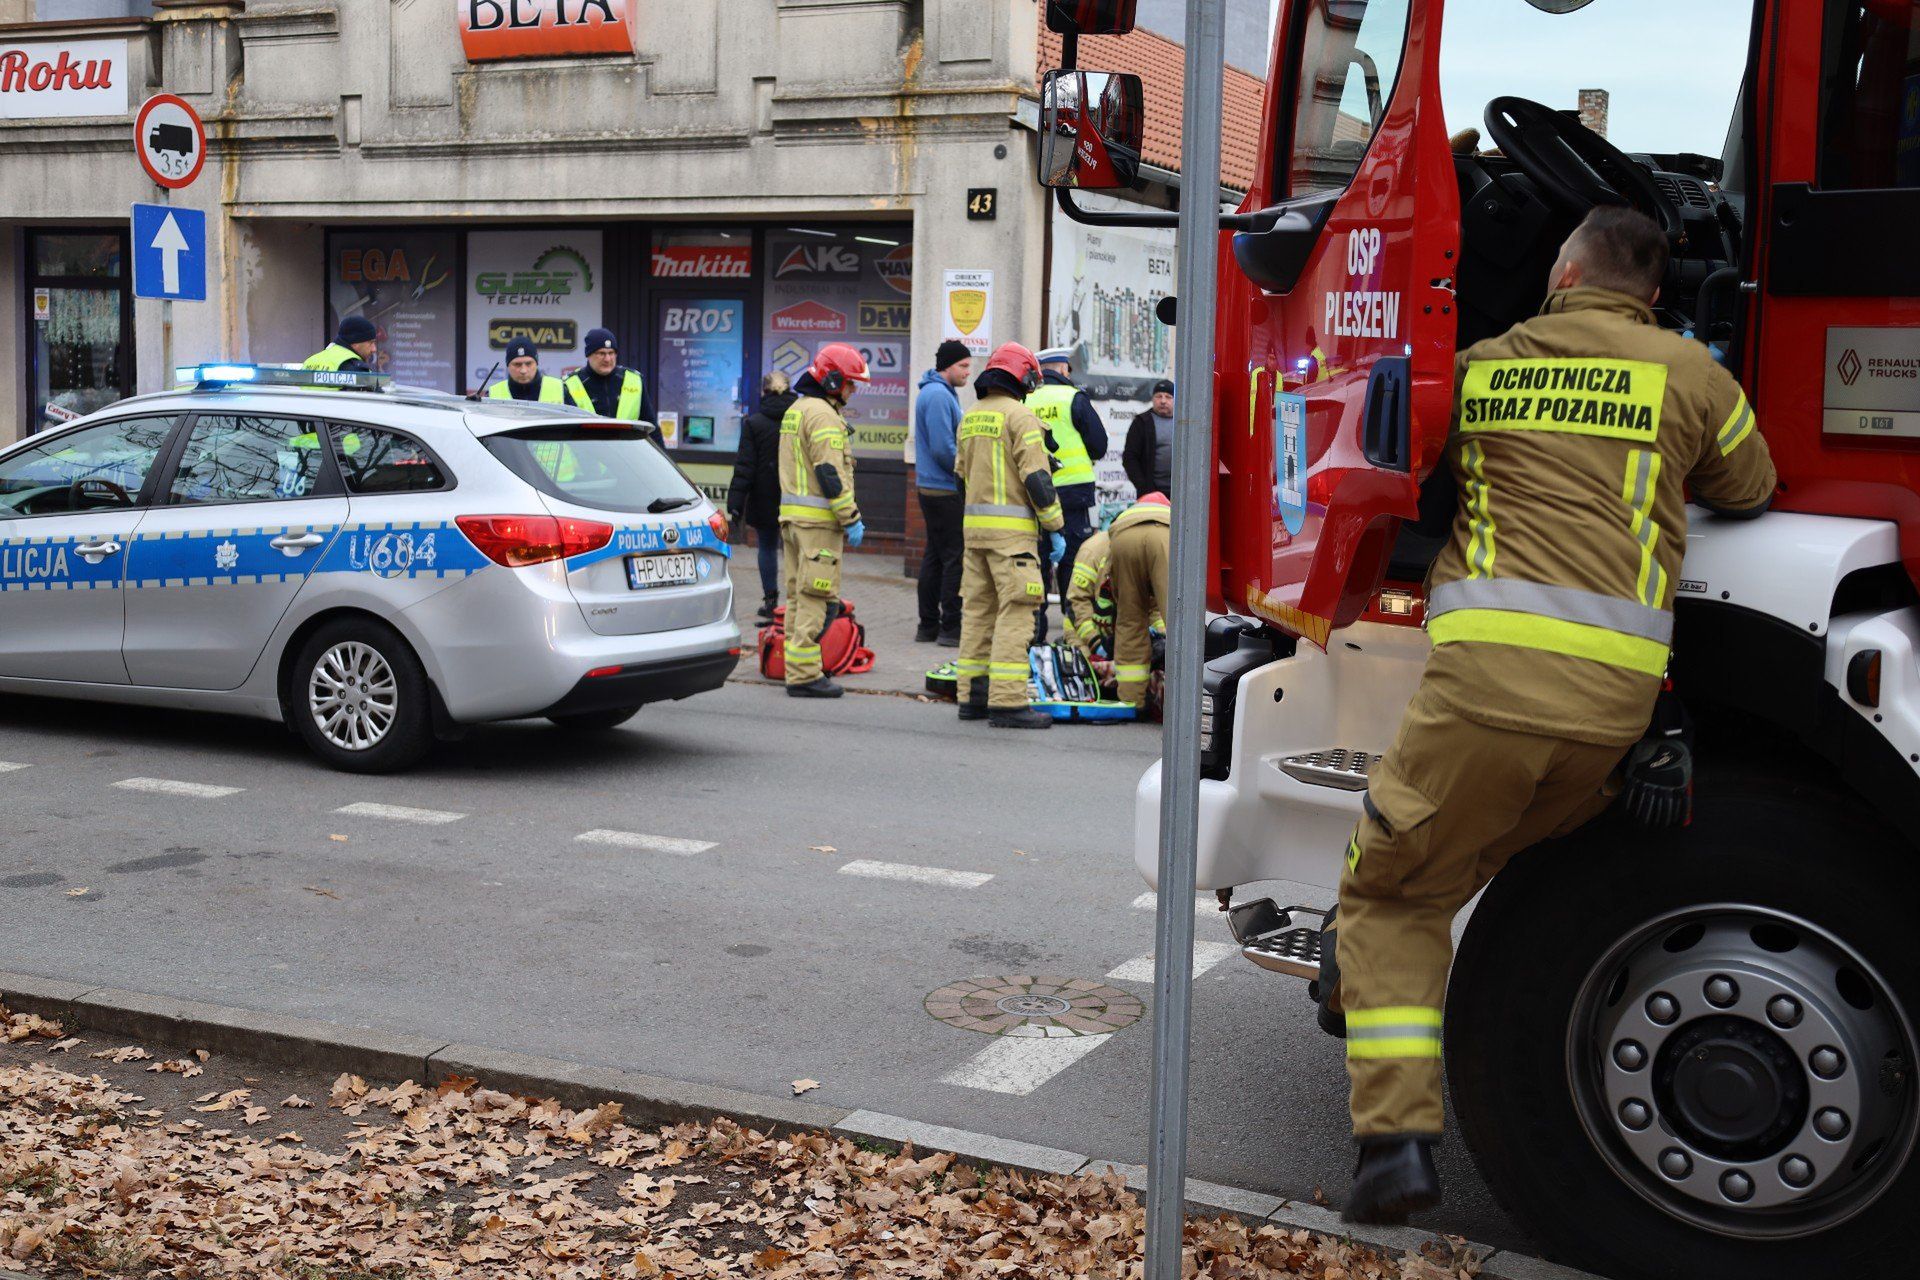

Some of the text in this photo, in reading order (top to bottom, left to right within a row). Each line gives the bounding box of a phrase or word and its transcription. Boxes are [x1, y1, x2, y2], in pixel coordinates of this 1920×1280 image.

[0, 50, 112, 92] Roku
[969, 194, 992, 213] 43
[818, 246, 860, 272] K2
[1347, 228, 1380, 275] OSP
[340, 249, 410, 281] EGA
[1148, 258, 1171, 276] BETA
[475, 272, 573, 295] GUIDE
[486, 295, 561, 305] TECHNIK
[664, 308, 734, 334] BROS
[1324, 291, 1400, 338] PLESZEW
[314, 372, 357, 384] POLICJA
[1489, 367, 1632, 394] OCHOTNICZA
[1868, 368, 1917, 378] TRUCKS
[1859, 416, 1868, 429] D
[349, 532, 437, 569] U684
[618, 533, 659, 550] POLICJA
[3, 547, 70, 578] LICJA
